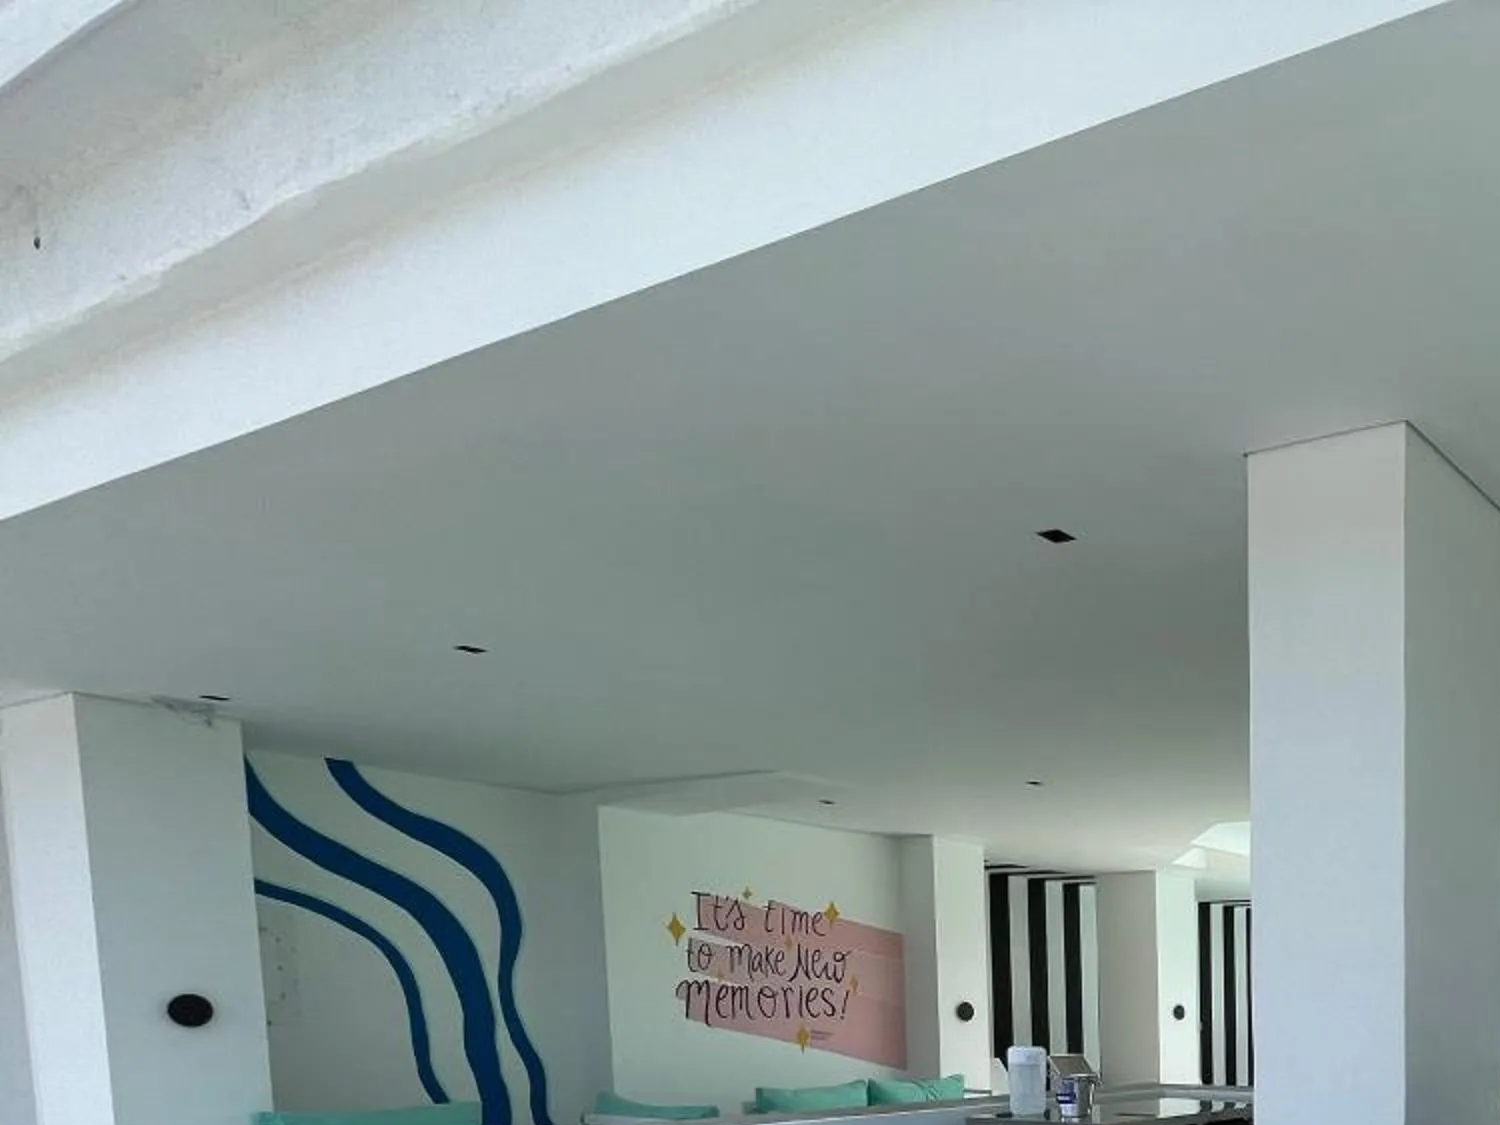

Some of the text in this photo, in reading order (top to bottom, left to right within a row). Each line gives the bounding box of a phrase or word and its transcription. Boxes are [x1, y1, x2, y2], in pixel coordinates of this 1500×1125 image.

[691, 891, 826, 937] It's time
[686, 938, 713, 973] to
